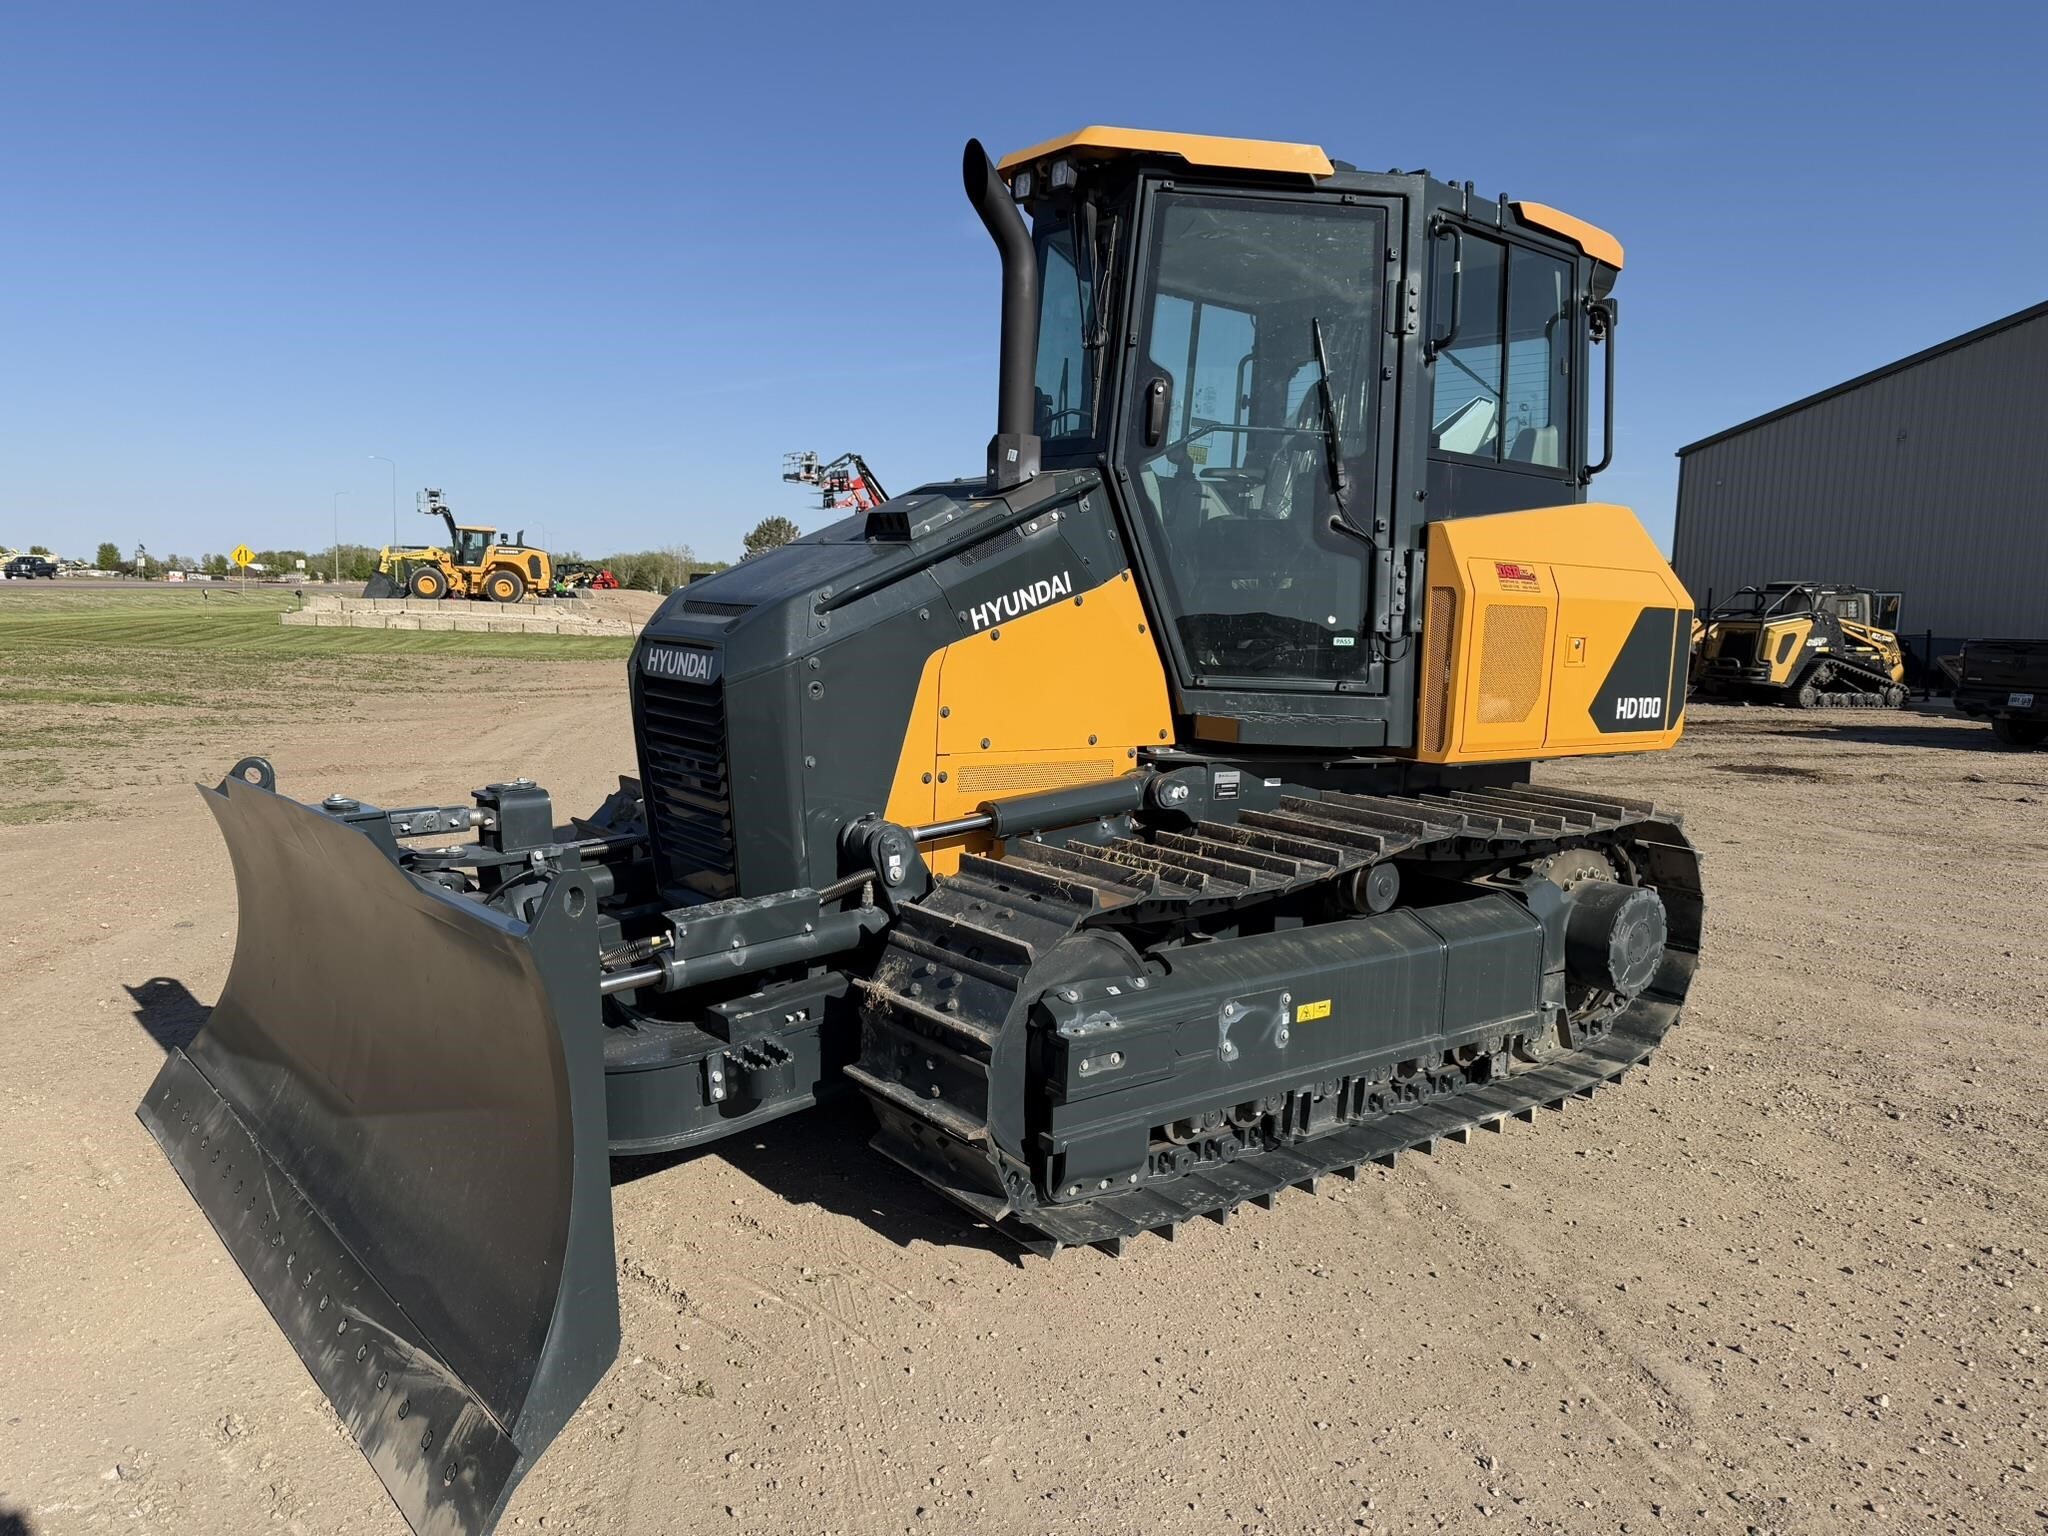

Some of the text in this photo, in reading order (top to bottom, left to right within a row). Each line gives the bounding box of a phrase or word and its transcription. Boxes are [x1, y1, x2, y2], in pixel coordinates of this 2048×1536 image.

[970, 570, 1072, 630] HYUNDAI
[1336, 638, 1352, 646] PASS
[647, 648, 713, 680] HYUNDAI
[1616, 697, 1661, 719] HD100
